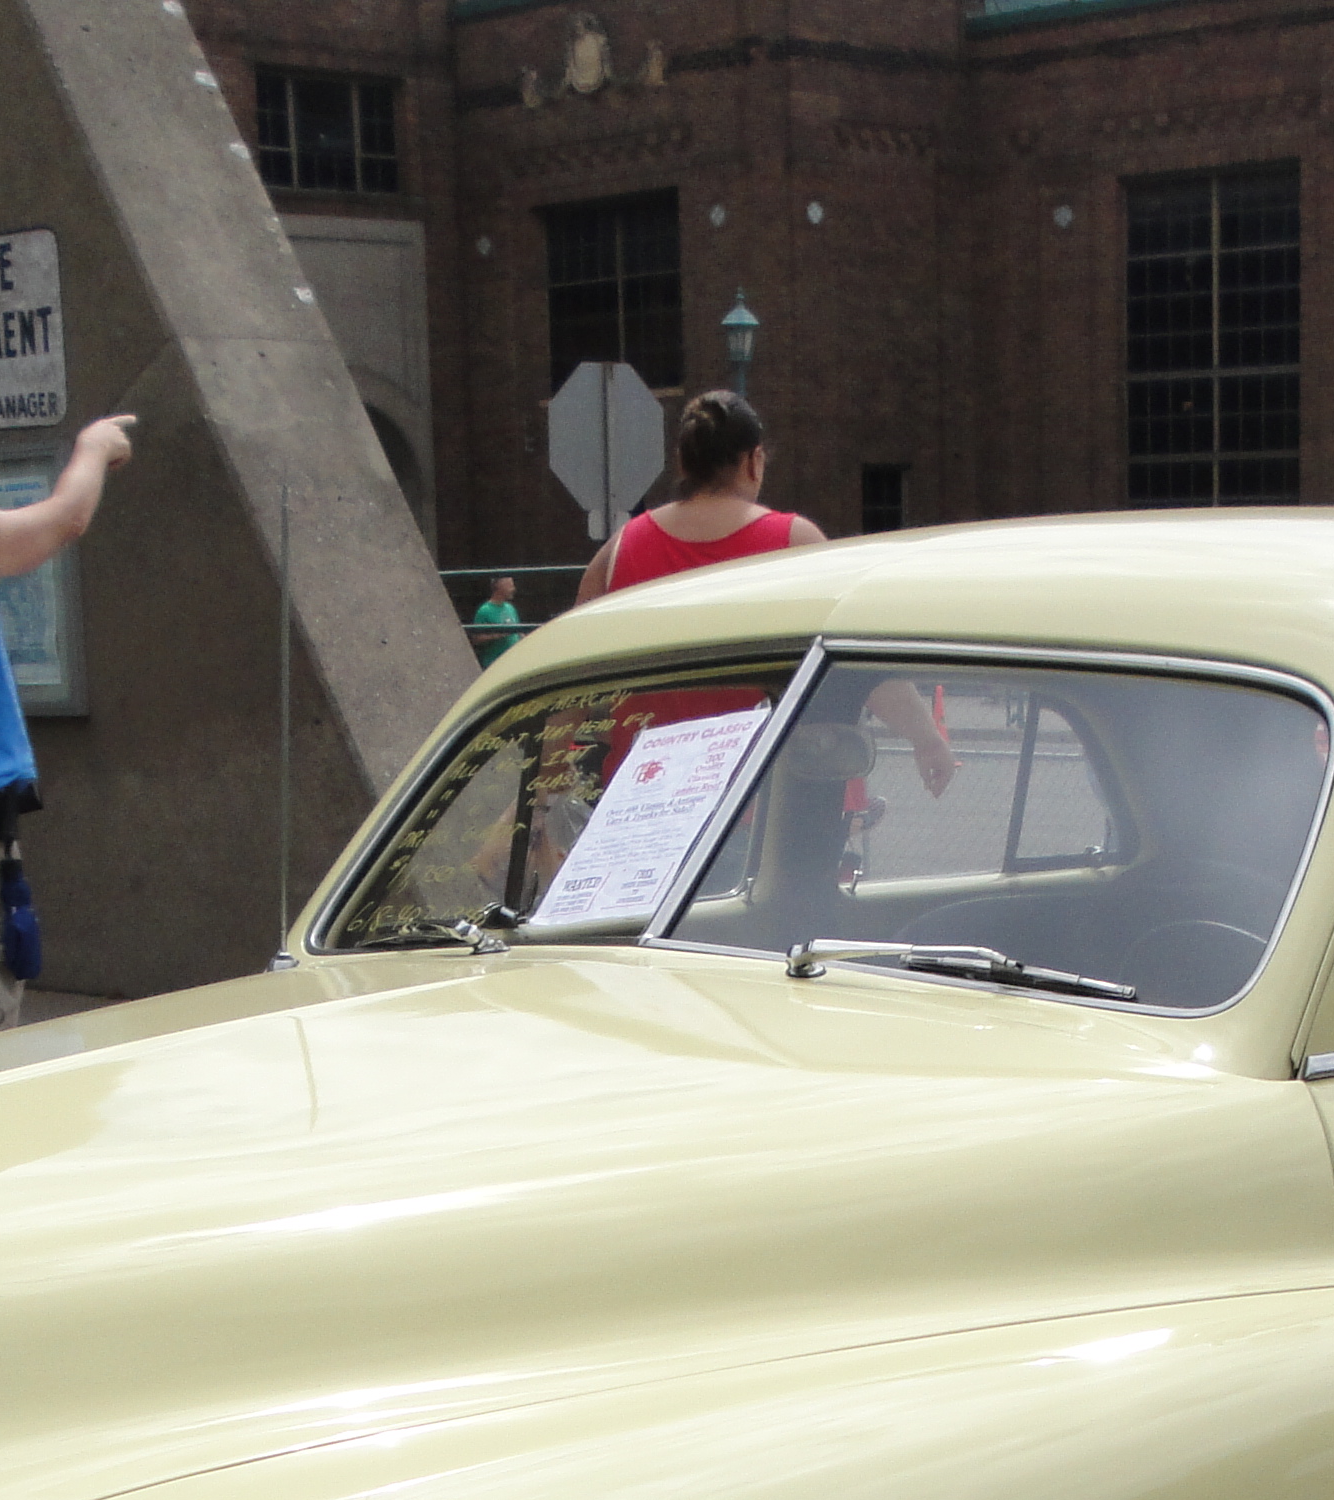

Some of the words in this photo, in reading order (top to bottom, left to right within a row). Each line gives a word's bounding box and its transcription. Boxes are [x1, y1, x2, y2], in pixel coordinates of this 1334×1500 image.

[643, 730, 699, 750] COUNTRY
[700, 721, 754, 740] CLASSIC
[708, 737, 740, 752] CARS
